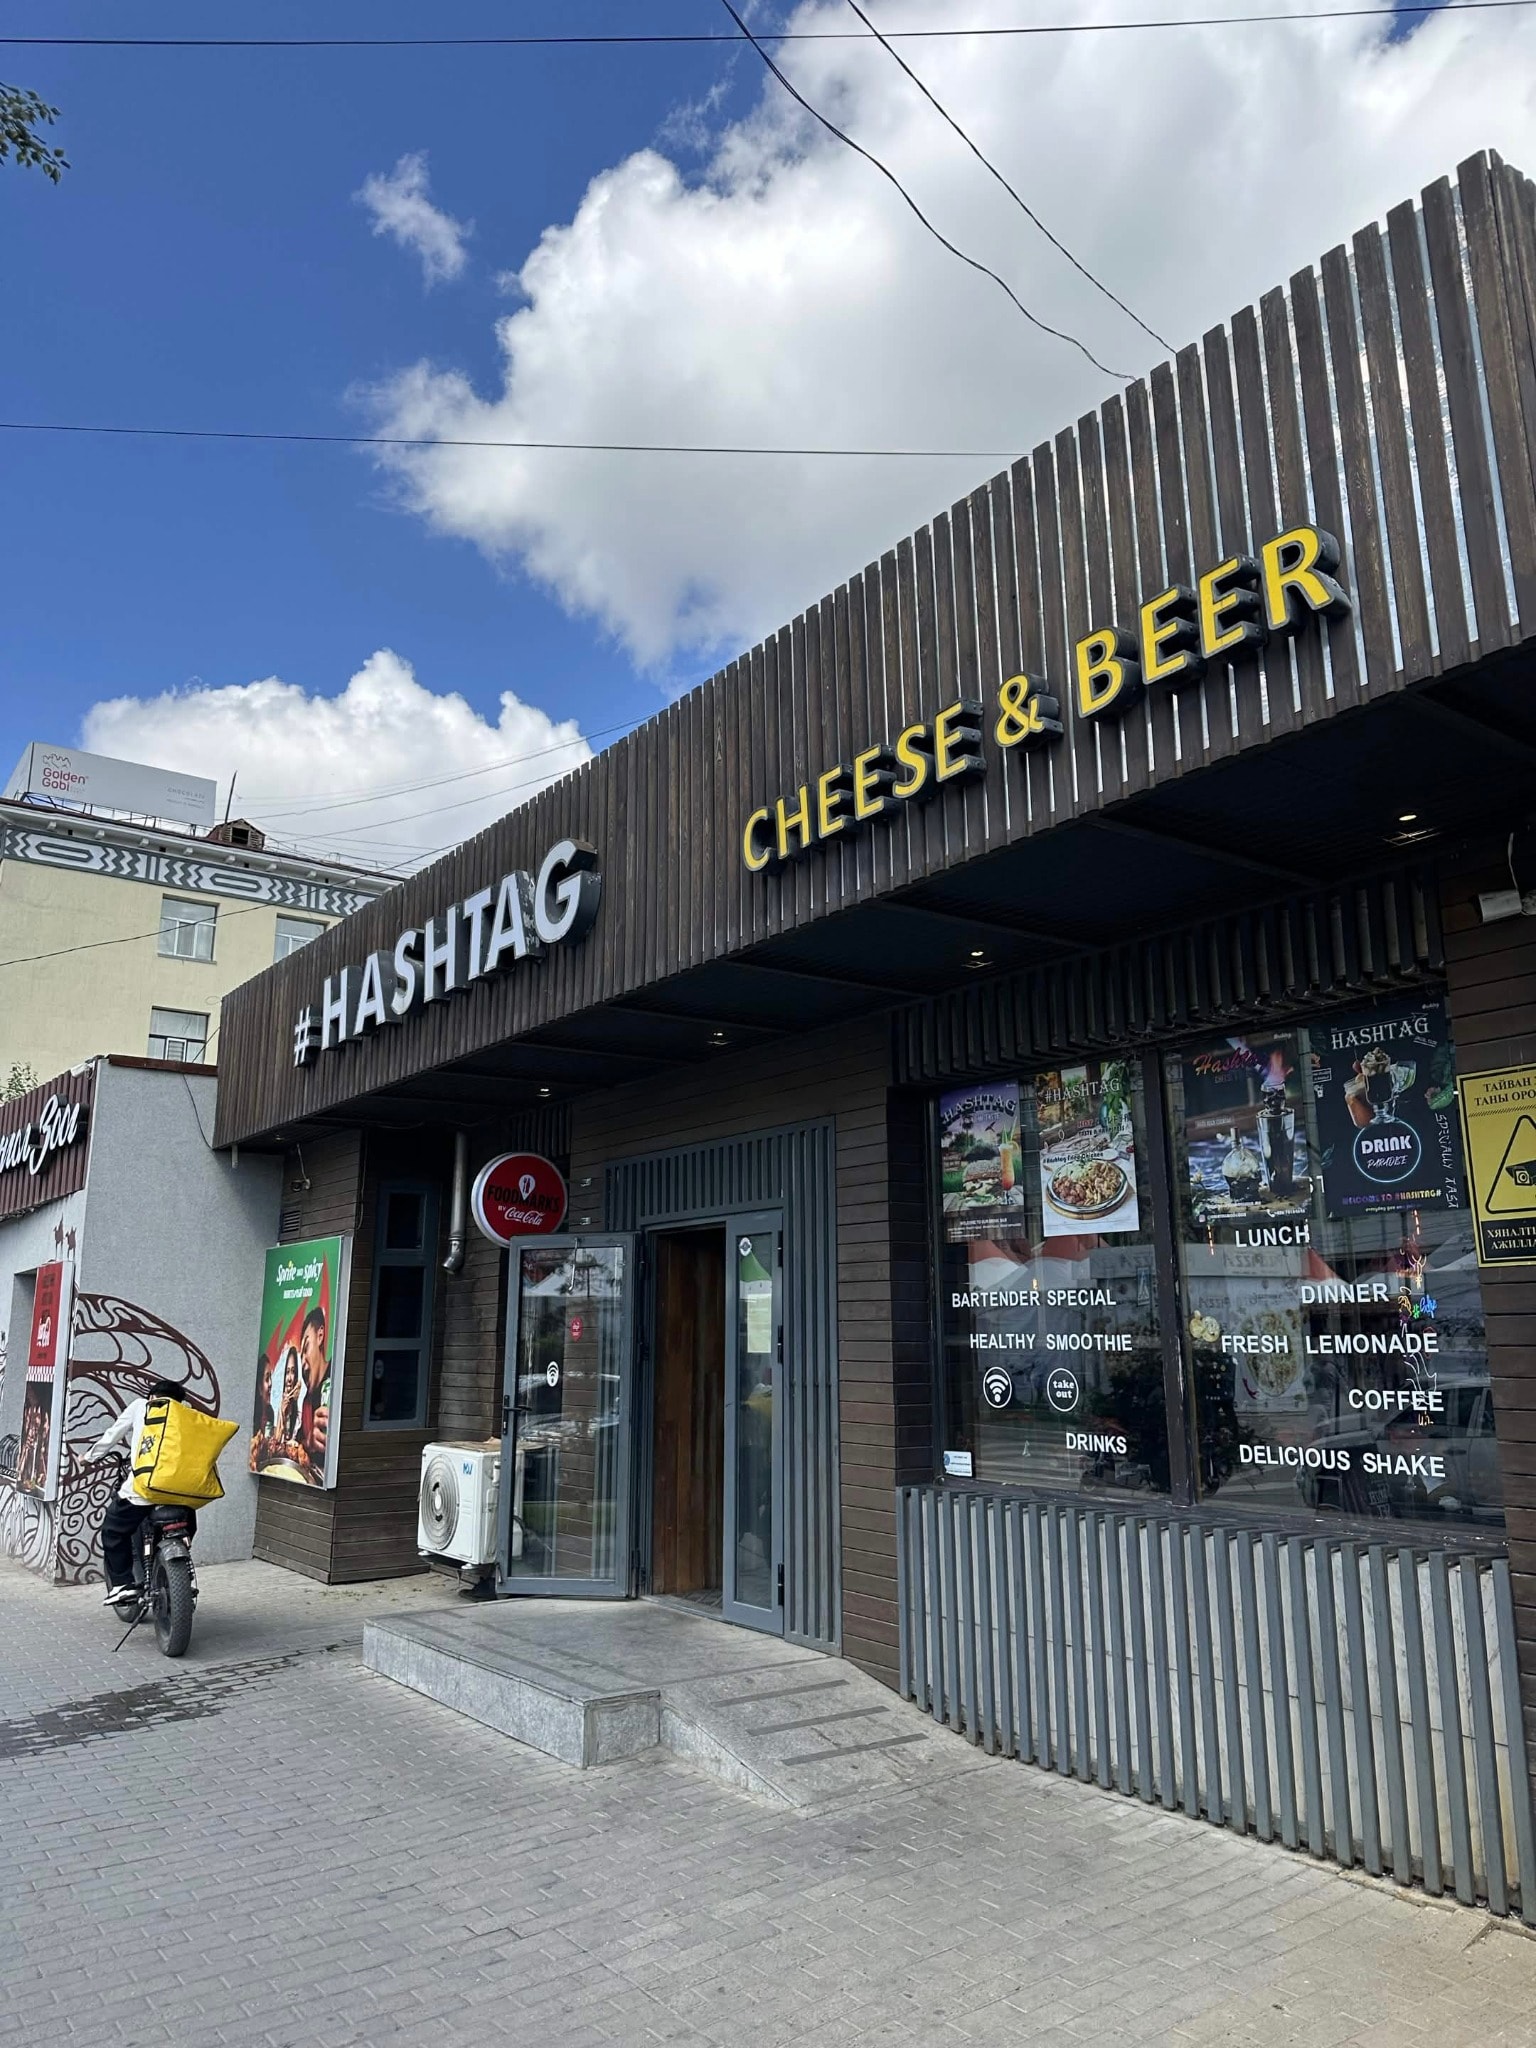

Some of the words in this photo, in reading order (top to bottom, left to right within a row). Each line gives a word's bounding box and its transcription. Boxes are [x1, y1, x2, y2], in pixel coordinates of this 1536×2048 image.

[742, 700, 968, 873] CHEESE
[994, 672, 1048, 749] &
[1075, 525, 1334, 719] BEER
[42, 777, 69, 791] Gobi
[43, 767, 86, 784] Golden
[1331, 1017, 1430, 1050] HASHTAG
[1044, 1078, 1121, 1103] #HASHTAG
[1484, 1077, 1531, 1092] ТАЙВАН
[941, 1094, 1017, 1125] HASHTAG
[1474, 1093, 1509, 1106] ТАНЫ
[1361, 1135, 1412, 1155] DRINK
[1381, 1193, 1393, 1202] TO
[1235, 1225, 1311, 1248] LUNCH
[276, 1261, 297, 1287] Sprite
[303, 1257, 324, 1284] spicy
[952, 1291, 1041, 1308] BARTENDER
[1047, 1289, 1117, 1306] SPECIAL
[1301, 1283, 1390, 1305] DINNER
[969, 1333, 1036, 1350] HEALTHY
[1046, 1333, 1133, 1351] SMOOTHIE
[1221, 1335, 1289, 1354] FRESH
[1305, 1332, 1439, 1355] LEMONADE
[1053, 1379, 1075, 1389] take
[1056, 1390, 1073, 1399] out
[1349, 1388, 1445, 1412] COFFEE
[1065, 1432, 1128, 1455] DRINKS
[1239, 1444, 1351, 1471] DELICIOUS
[1363, 1452, 1446, 1477] SHAKE
